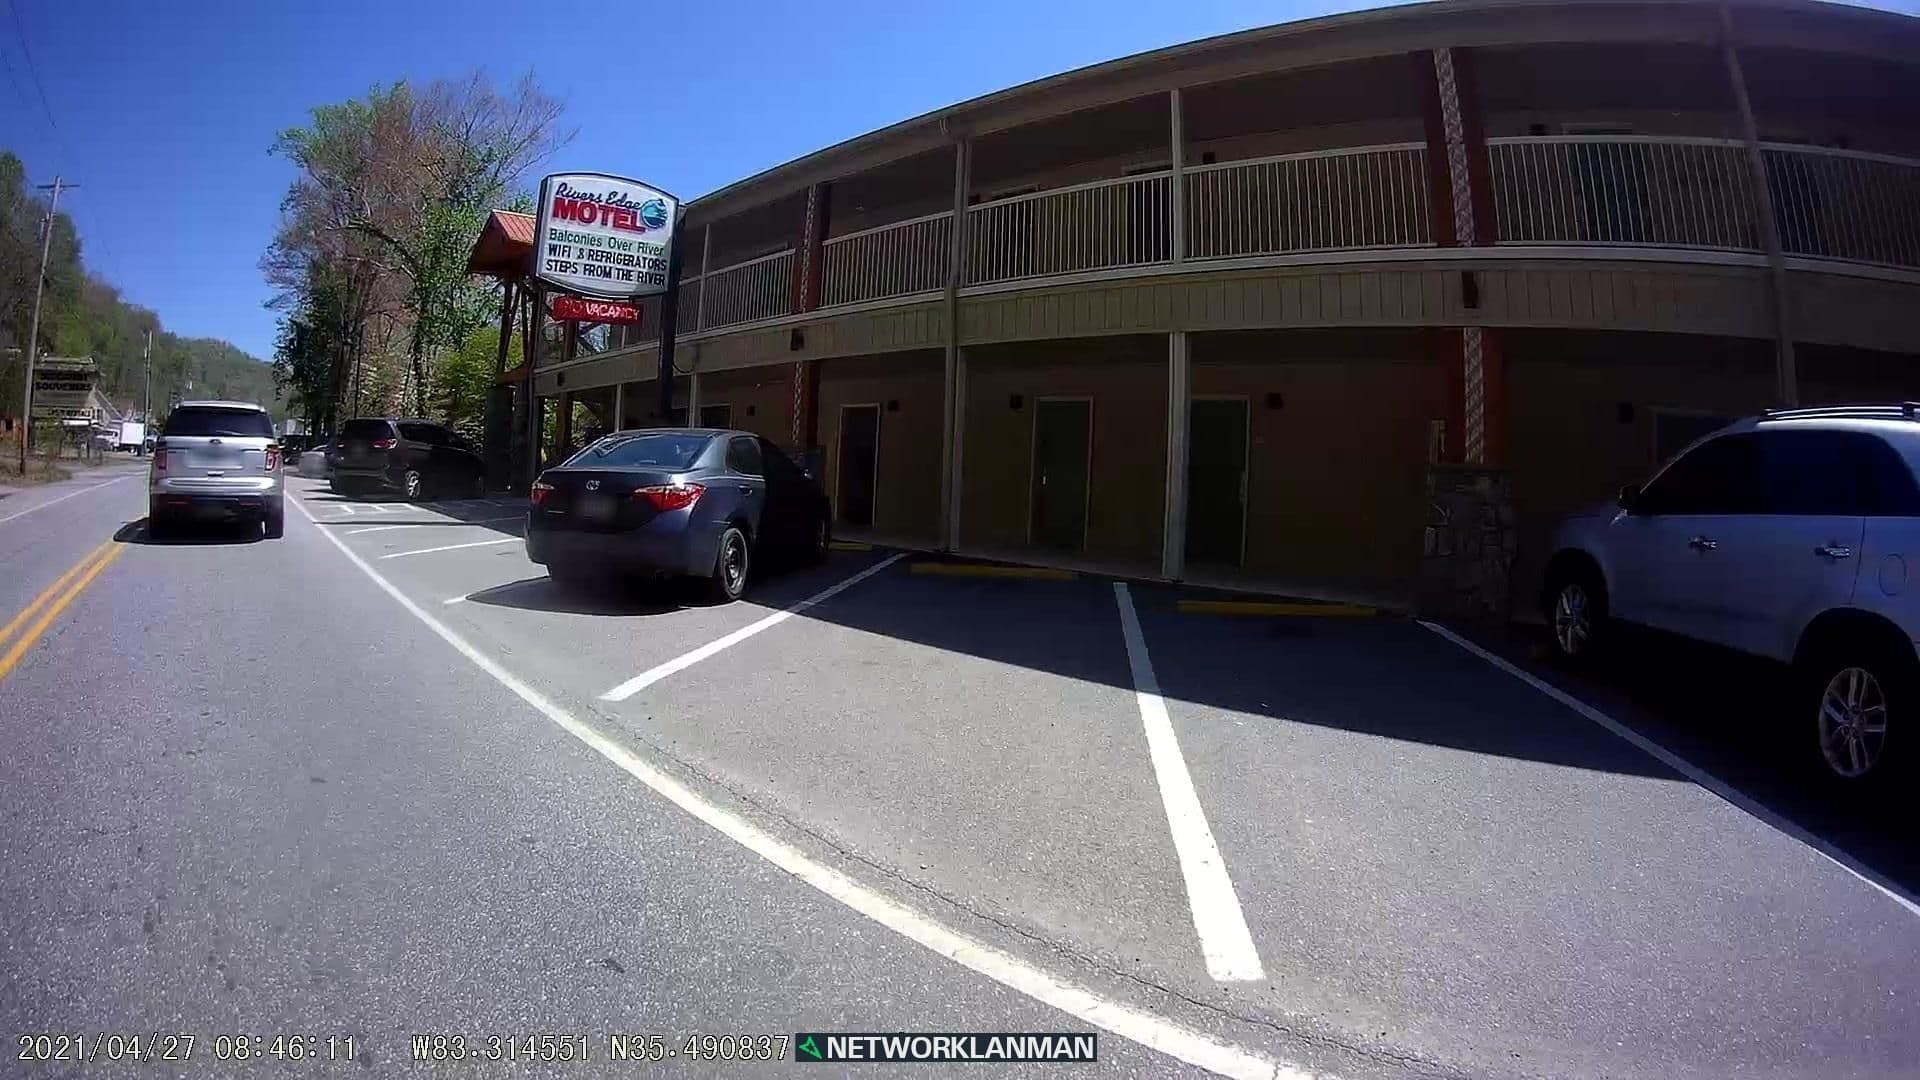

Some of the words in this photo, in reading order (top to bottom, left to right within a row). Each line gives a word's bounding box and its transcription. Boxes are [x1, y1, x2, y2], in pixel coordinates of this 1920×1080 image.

[555, 182, 603, 204] Rivers
[604, 191, 642, 210] Edge
[552, 197, 645, 234] MOTEL
[549, 228, 602, 247] Balconies
[608, 237, 632, 251] Over
[637, 242, 664, 257] River
[548, 243, 571, 259] WIFI
[577, 249, 585, 259] &
[587, 249, 667, 272] REFRIGERATORS
[546, 259, 578, 274] STEPS
[583, 263, 612, 279] FROM
[615, 268, 633, 282] THE
[637, 271, 665, 286] RIVER
[585, 304, 640, 321] VACANCY
